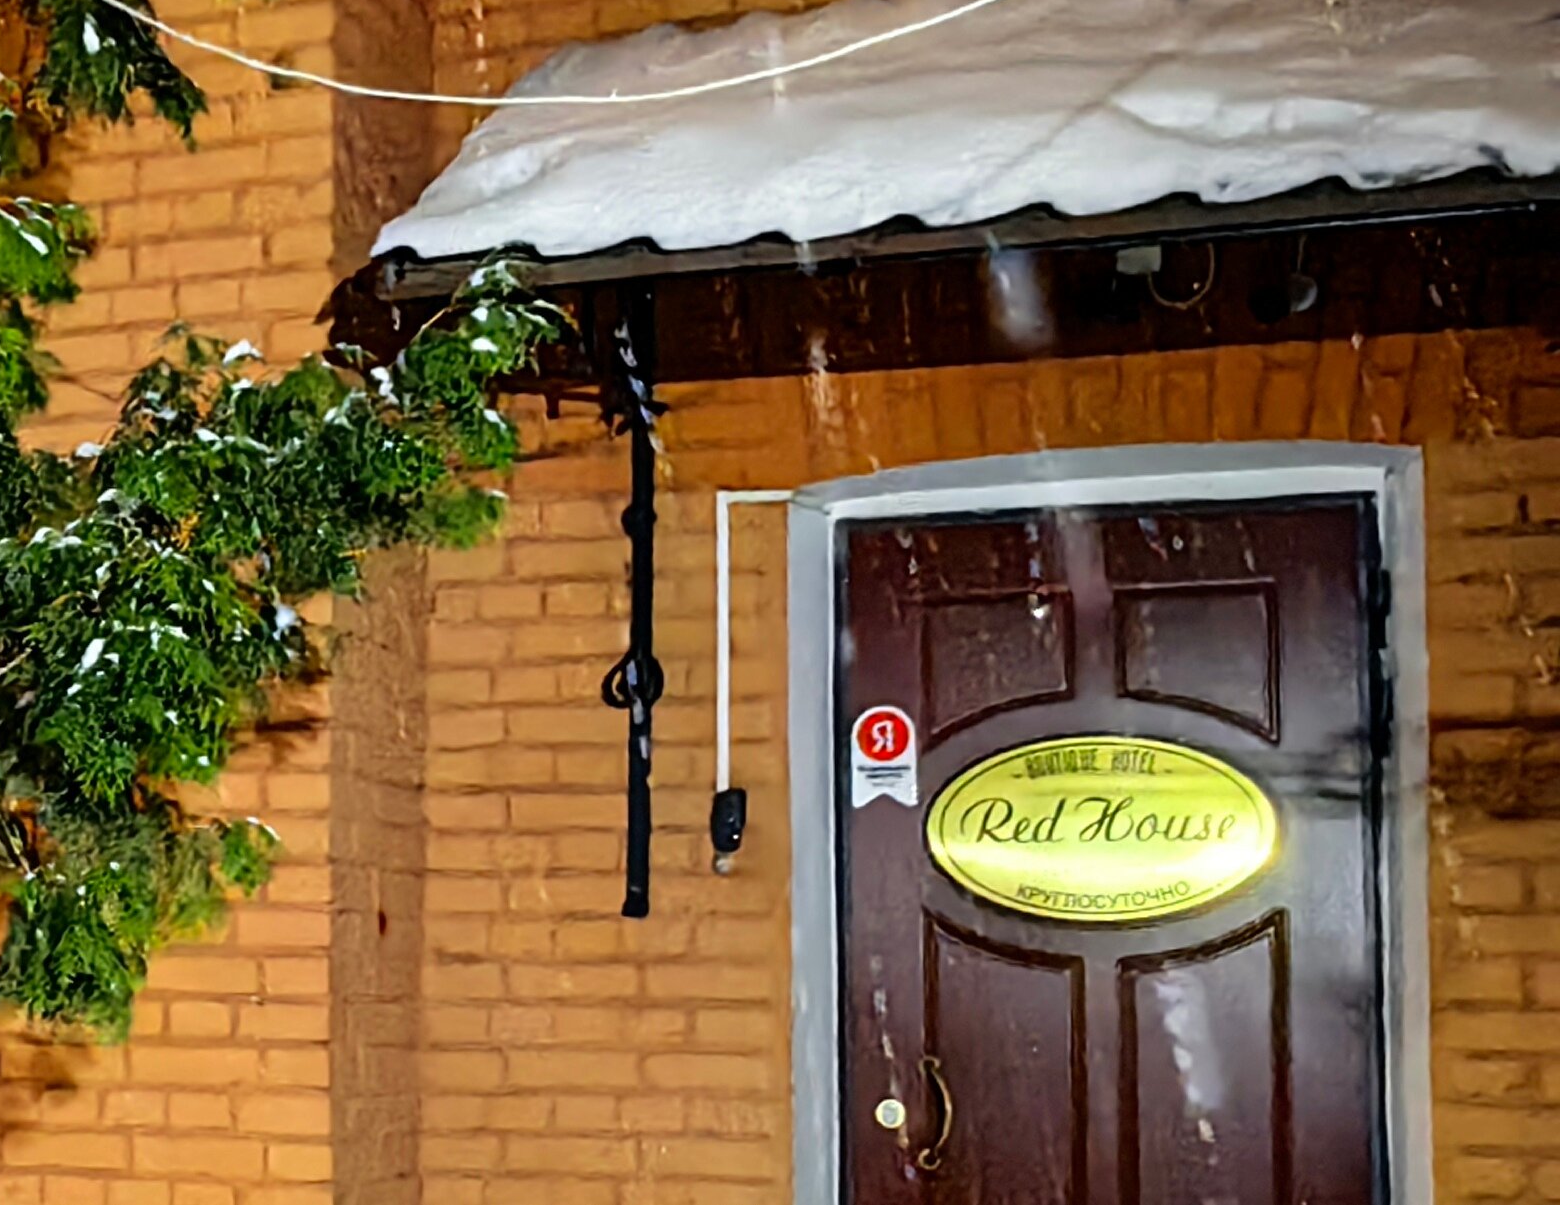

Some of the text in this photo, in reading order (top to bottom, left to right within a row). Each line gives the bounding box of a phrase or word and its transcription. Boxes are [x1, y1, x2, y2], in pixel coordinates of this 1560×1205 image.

[871, 719, 895, 753] Я
[1025, 748, 1157, 779] BOUTIQUE HOTEL
[960, 796, 1237, 844] Red House
[1016, 880, 1191, 910] КРУГЛОСУТОЧНО
